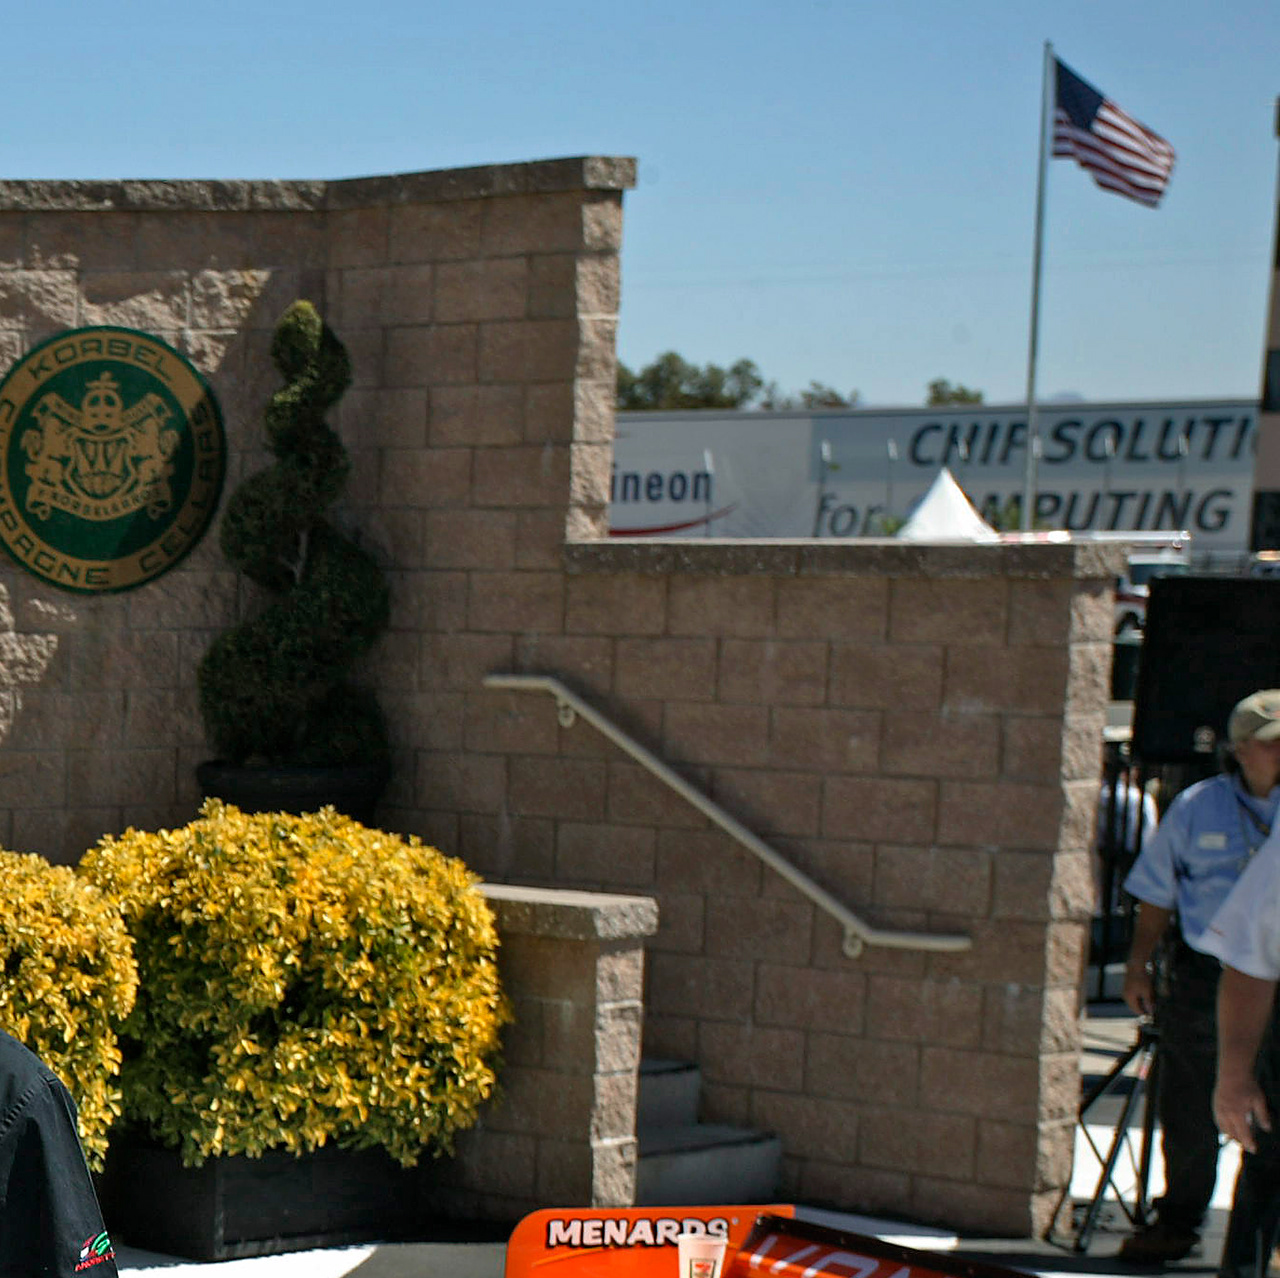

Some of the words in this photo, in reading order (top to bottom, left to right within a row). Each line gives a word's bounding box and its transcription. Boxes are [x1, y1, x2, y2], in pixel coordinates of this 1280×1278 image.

[29, 338, 173, 382] KORBEL
[1044, 416, 1258, 464] SOLUTI
[814, 491, 884, 538] for
